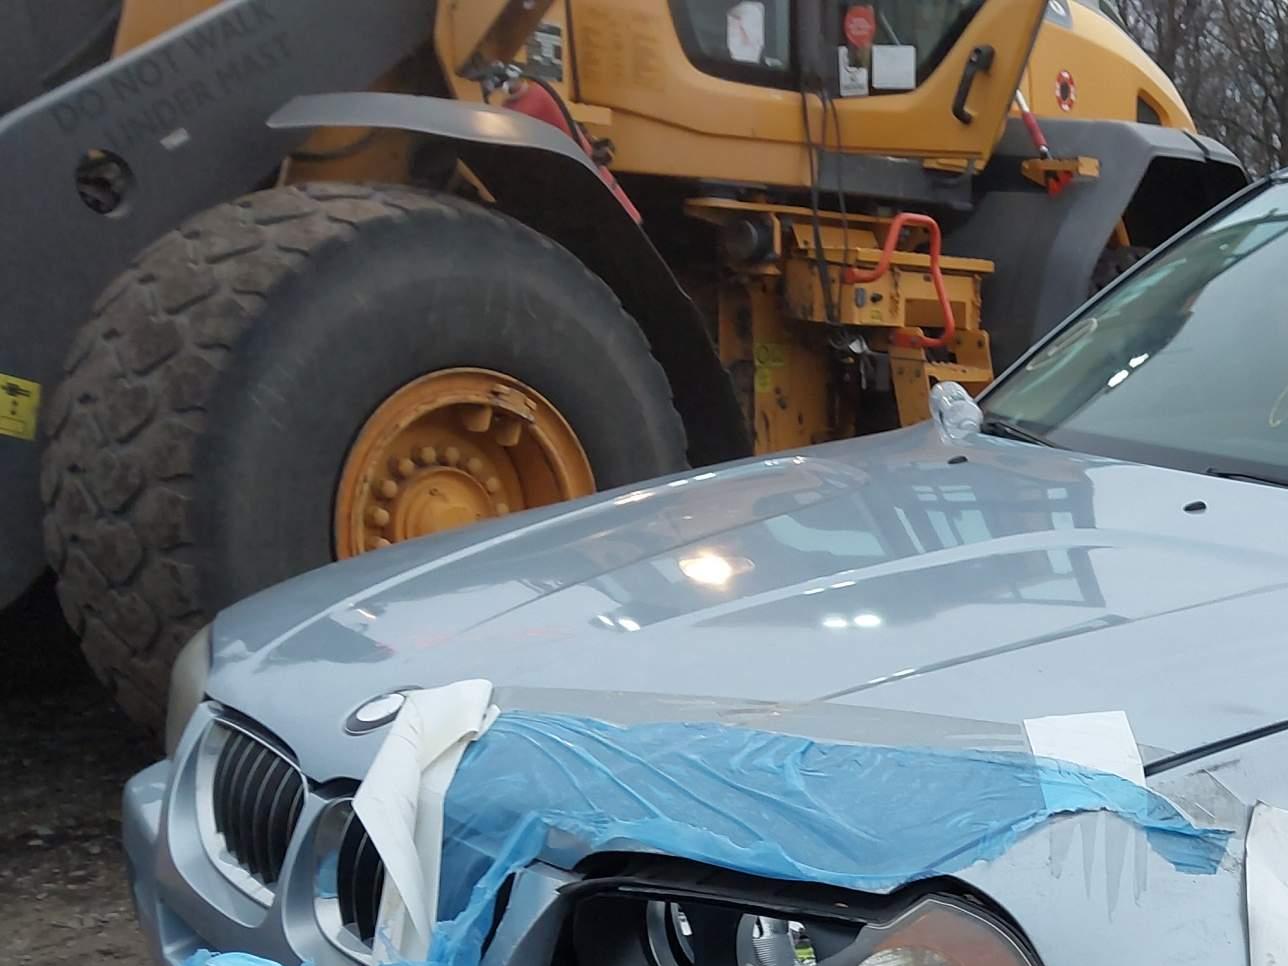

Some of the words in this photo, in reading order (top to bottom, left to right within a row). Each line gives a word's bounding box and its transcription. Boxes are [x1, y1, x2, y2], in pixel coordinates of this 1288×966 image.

[52, 88, 106, 133] DO
[110, 44, 180, 102] NOT
[182, 1, 276, 58] WALK
[103, 79, 216, 152] UNDER
[215, 31, 293, 96] MAST
